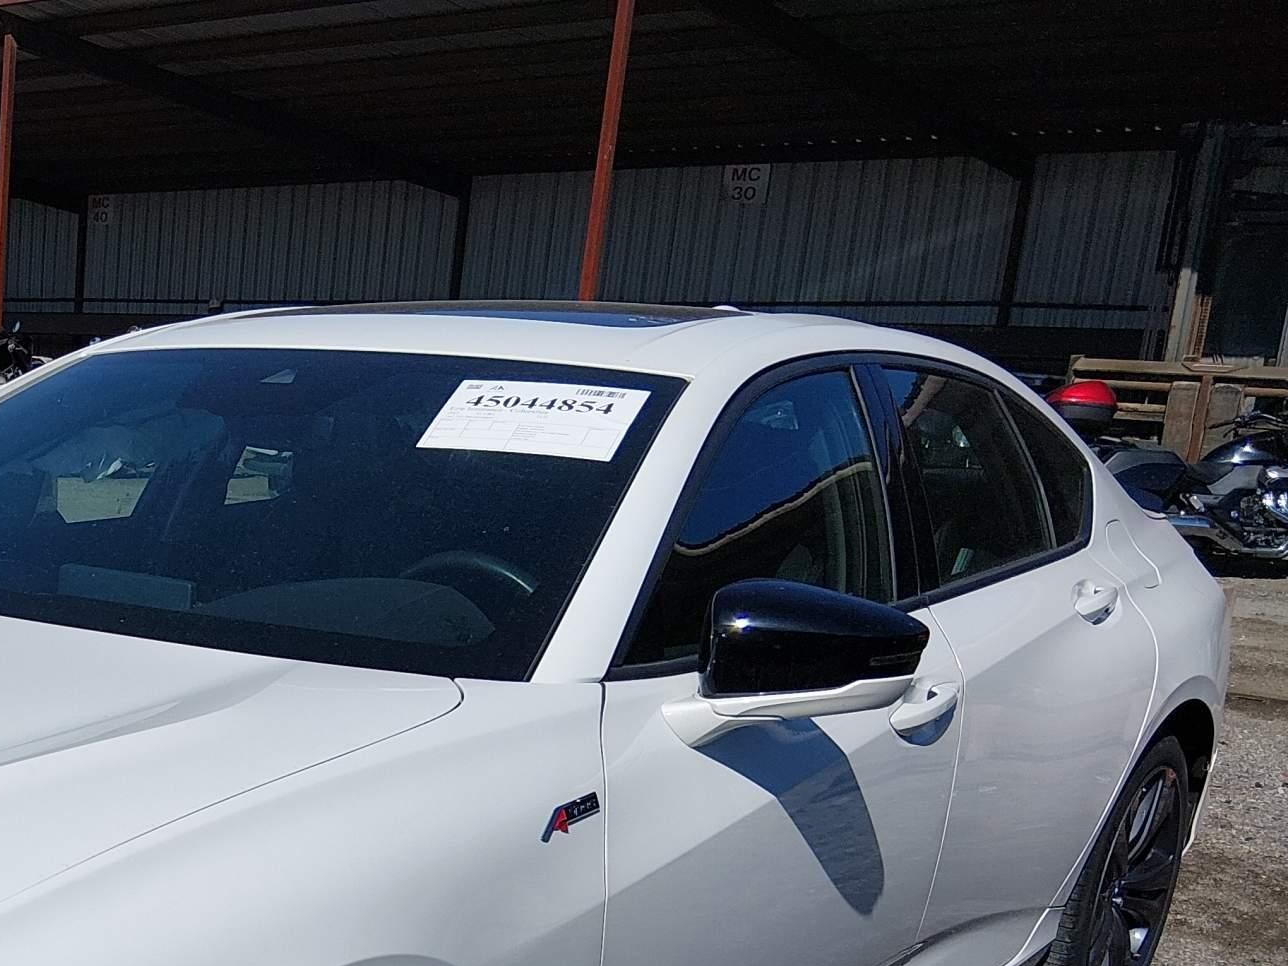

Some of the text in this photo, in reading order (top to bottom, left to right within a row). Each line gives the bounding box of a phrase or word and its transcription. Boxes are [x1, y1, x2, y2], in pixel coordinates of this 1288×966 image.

[731, 167, 761, 182] MC
[731, 186, 756, 201] 30
[92, 197, 110, 209] MC
[93, 211, 108, 223] 40
[466, 394, 615, 415] 45044854
